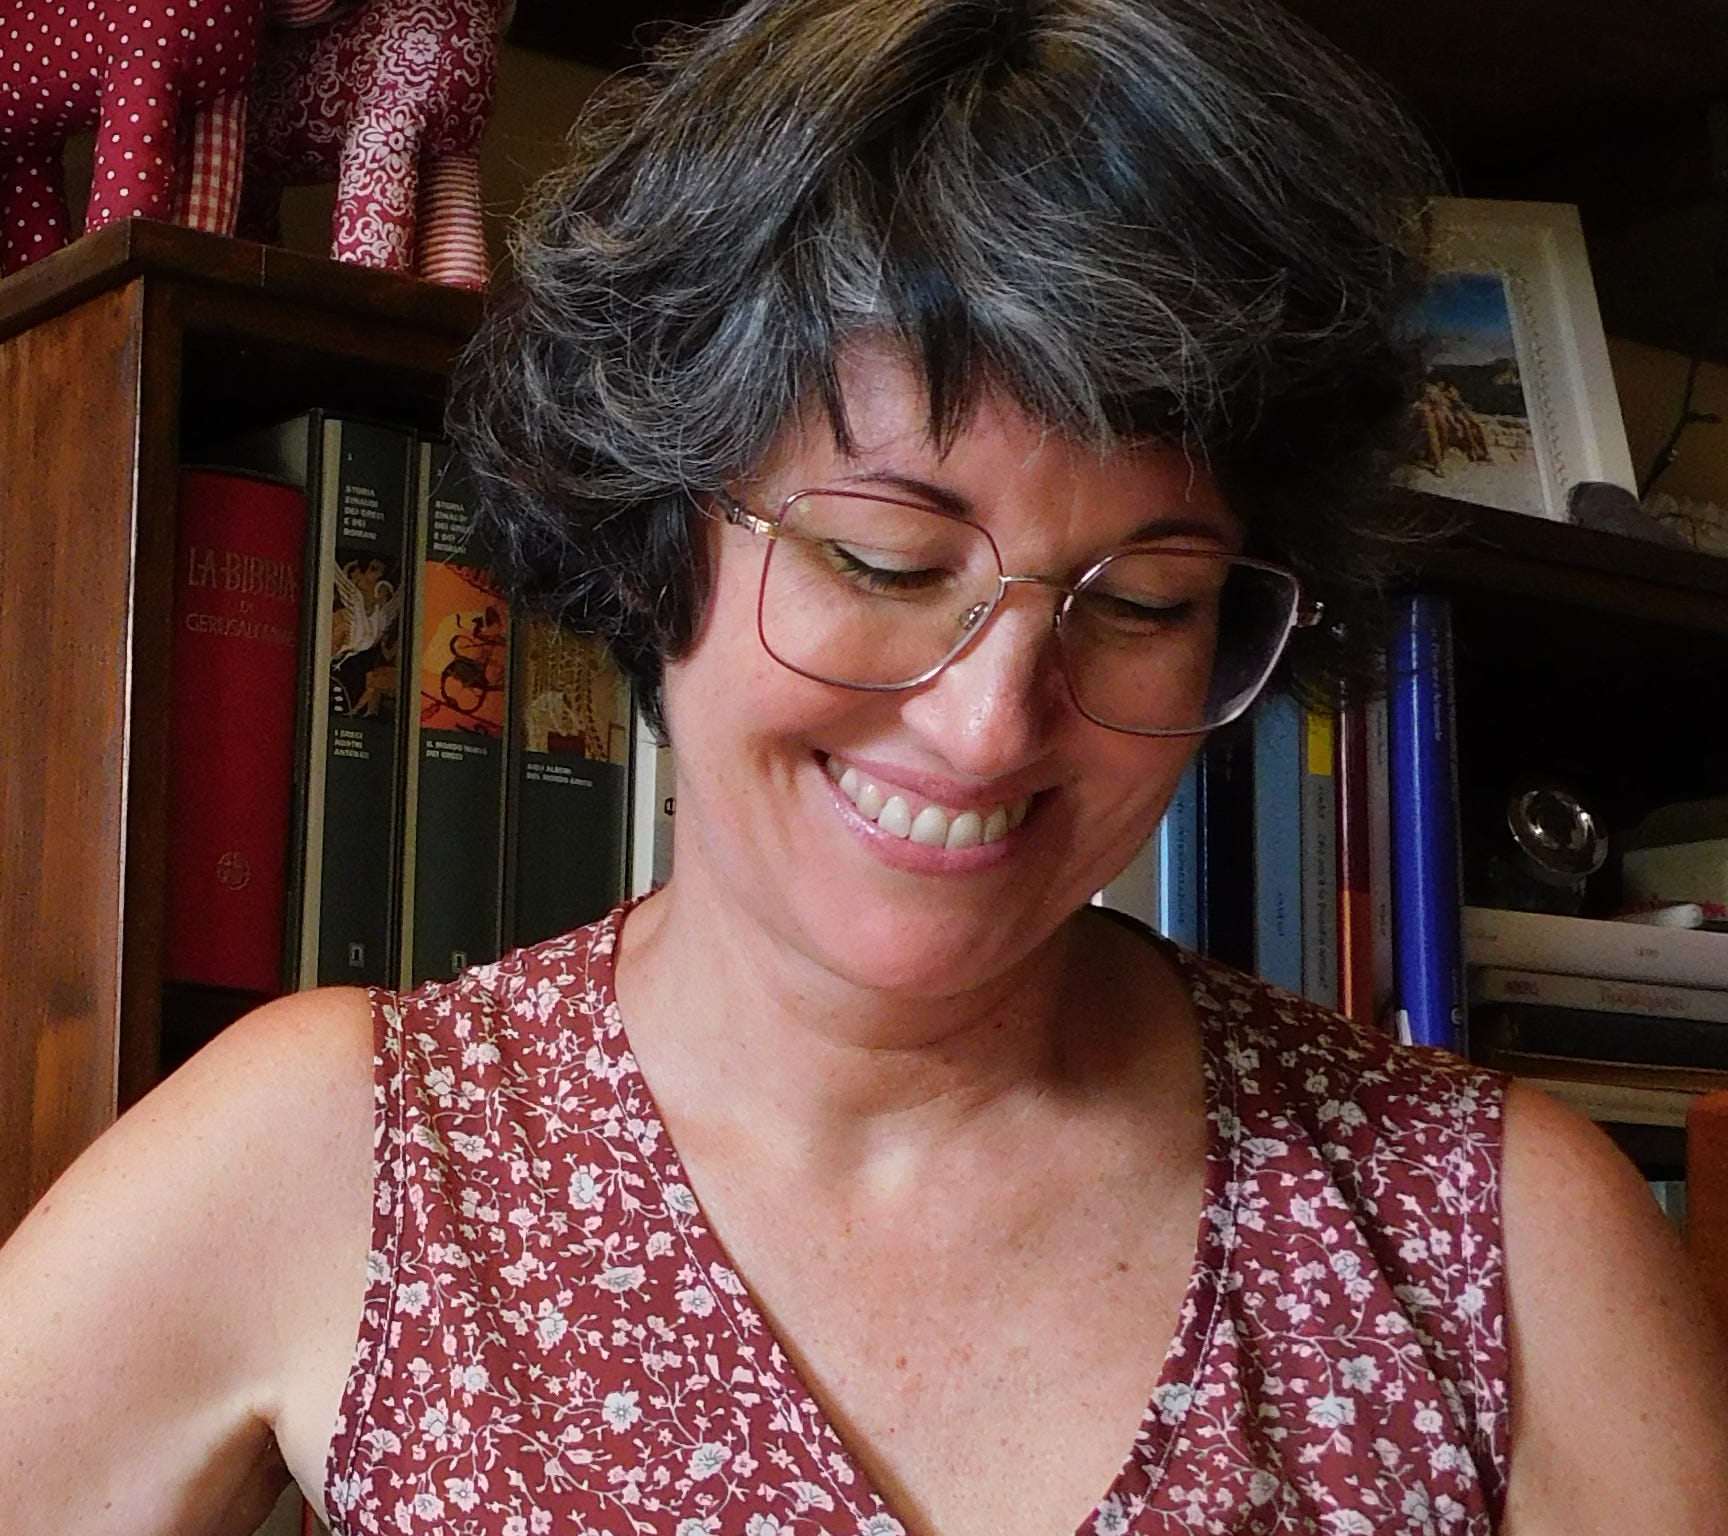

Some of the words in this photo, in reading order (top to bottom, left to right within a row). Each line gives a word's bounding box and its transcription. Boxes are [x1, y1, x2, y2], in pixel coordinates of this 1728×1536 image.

[345, 484, 376, 497] STORIA
[187, 545, 218, 590] LA
[223, 552, 298, 604] BIBBIA
